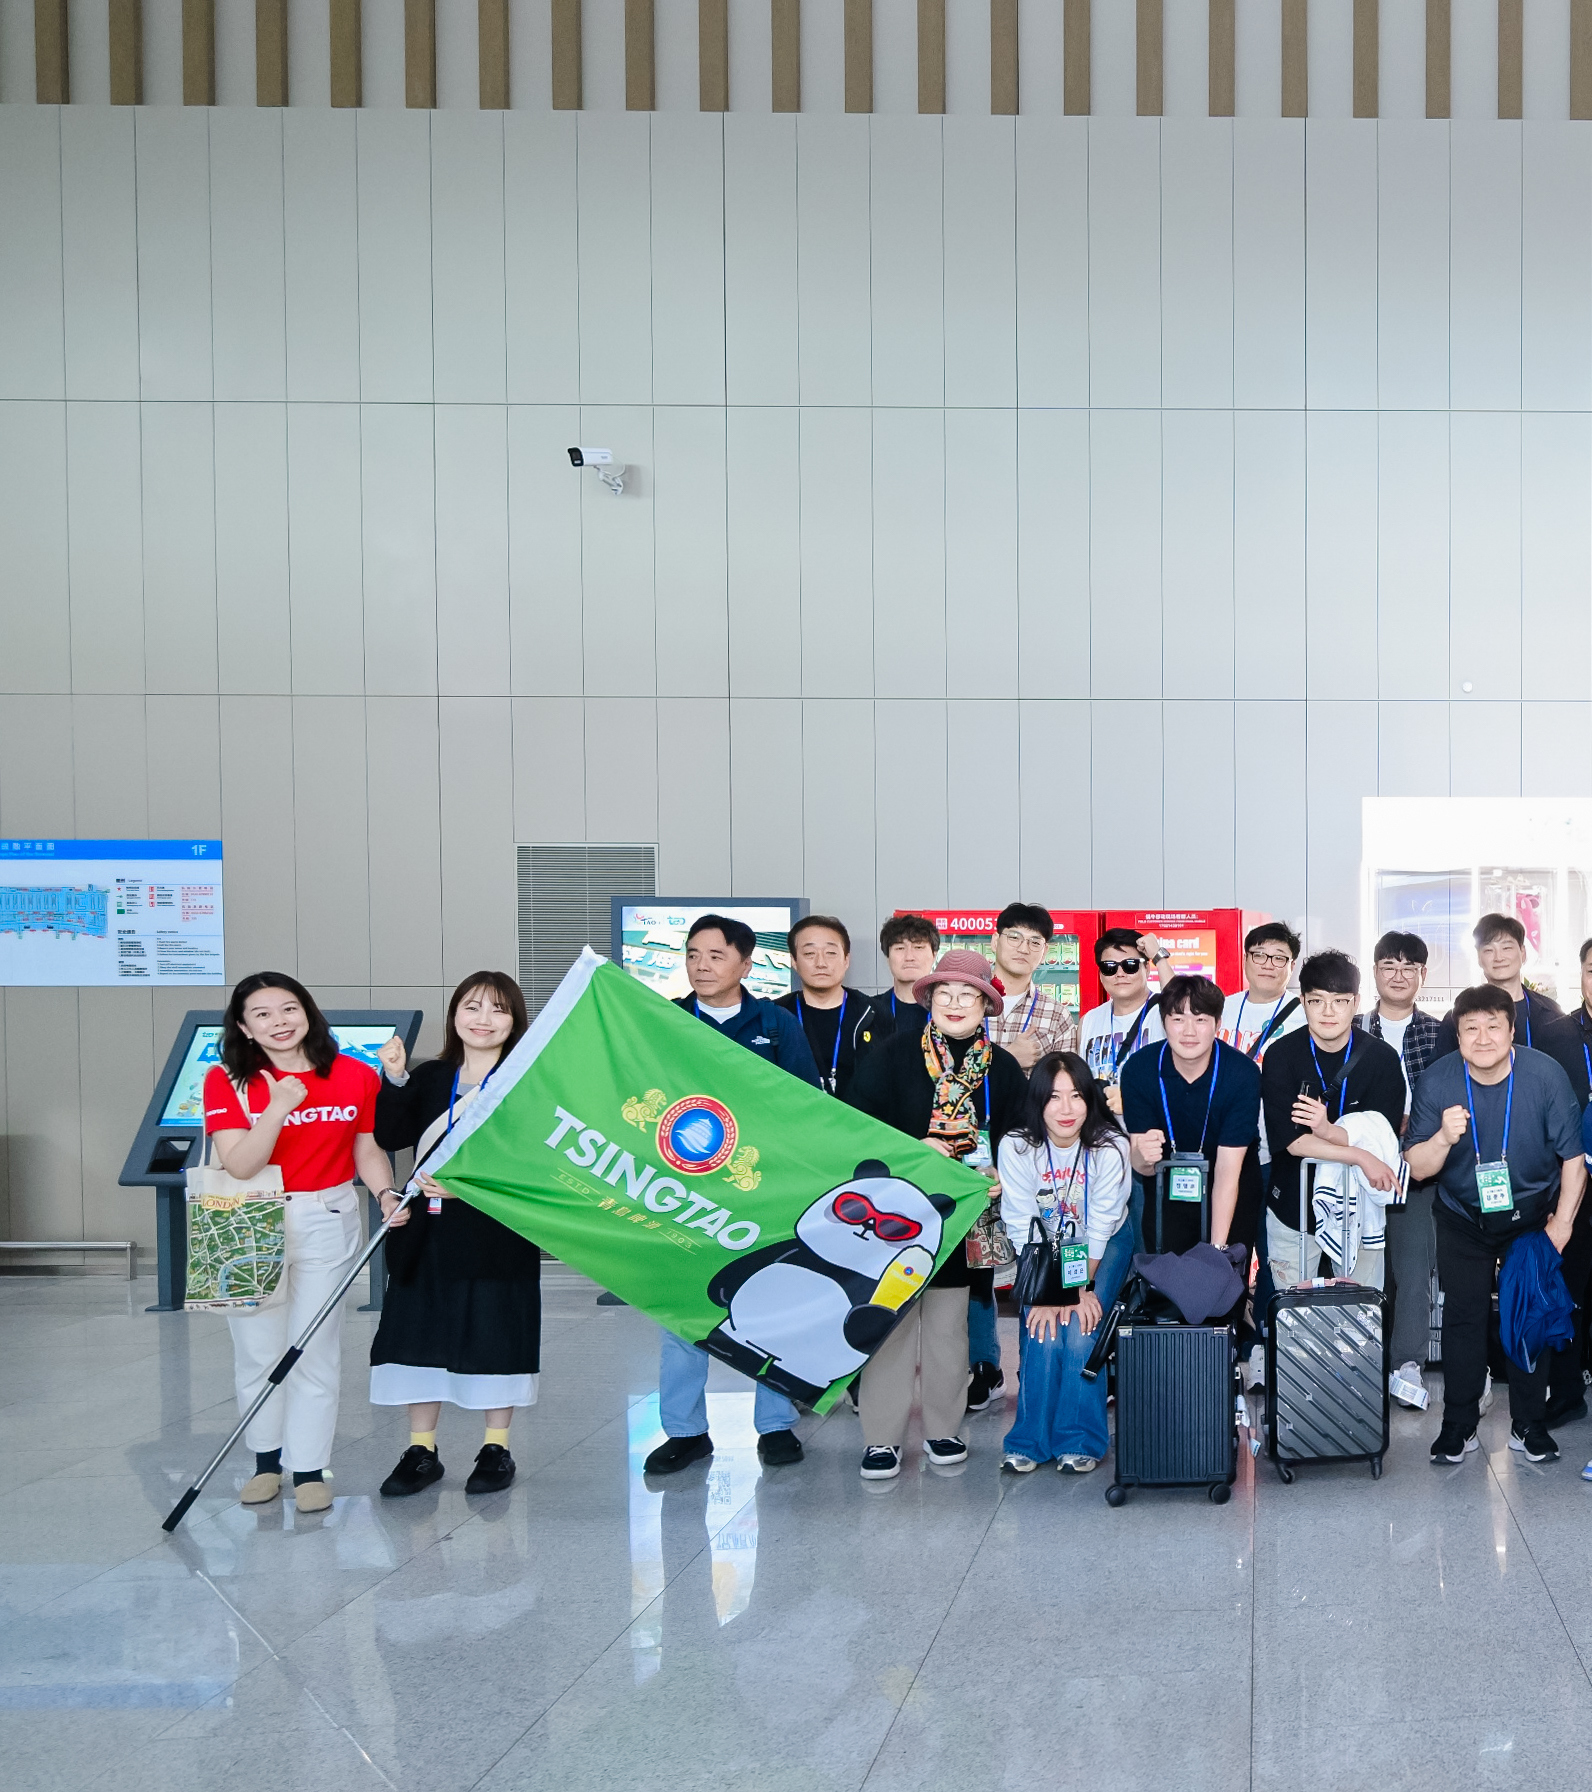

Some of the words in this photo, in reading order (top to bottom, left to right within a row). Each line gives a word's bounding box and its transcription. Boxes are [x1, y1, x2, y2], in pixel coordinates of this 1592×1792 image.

[191, 845, 206, 855] 1F
[950, 917, 997, 930] 40005
[1177, 937, 1199, 949] card
[250, 1105, 357, 1126] TNGTAO
[544, 1105, 761, 1250] TSINGTAO
[558, 1173, 590, 1195] ESTD
[666, 1230, 692, 1249] 1903
